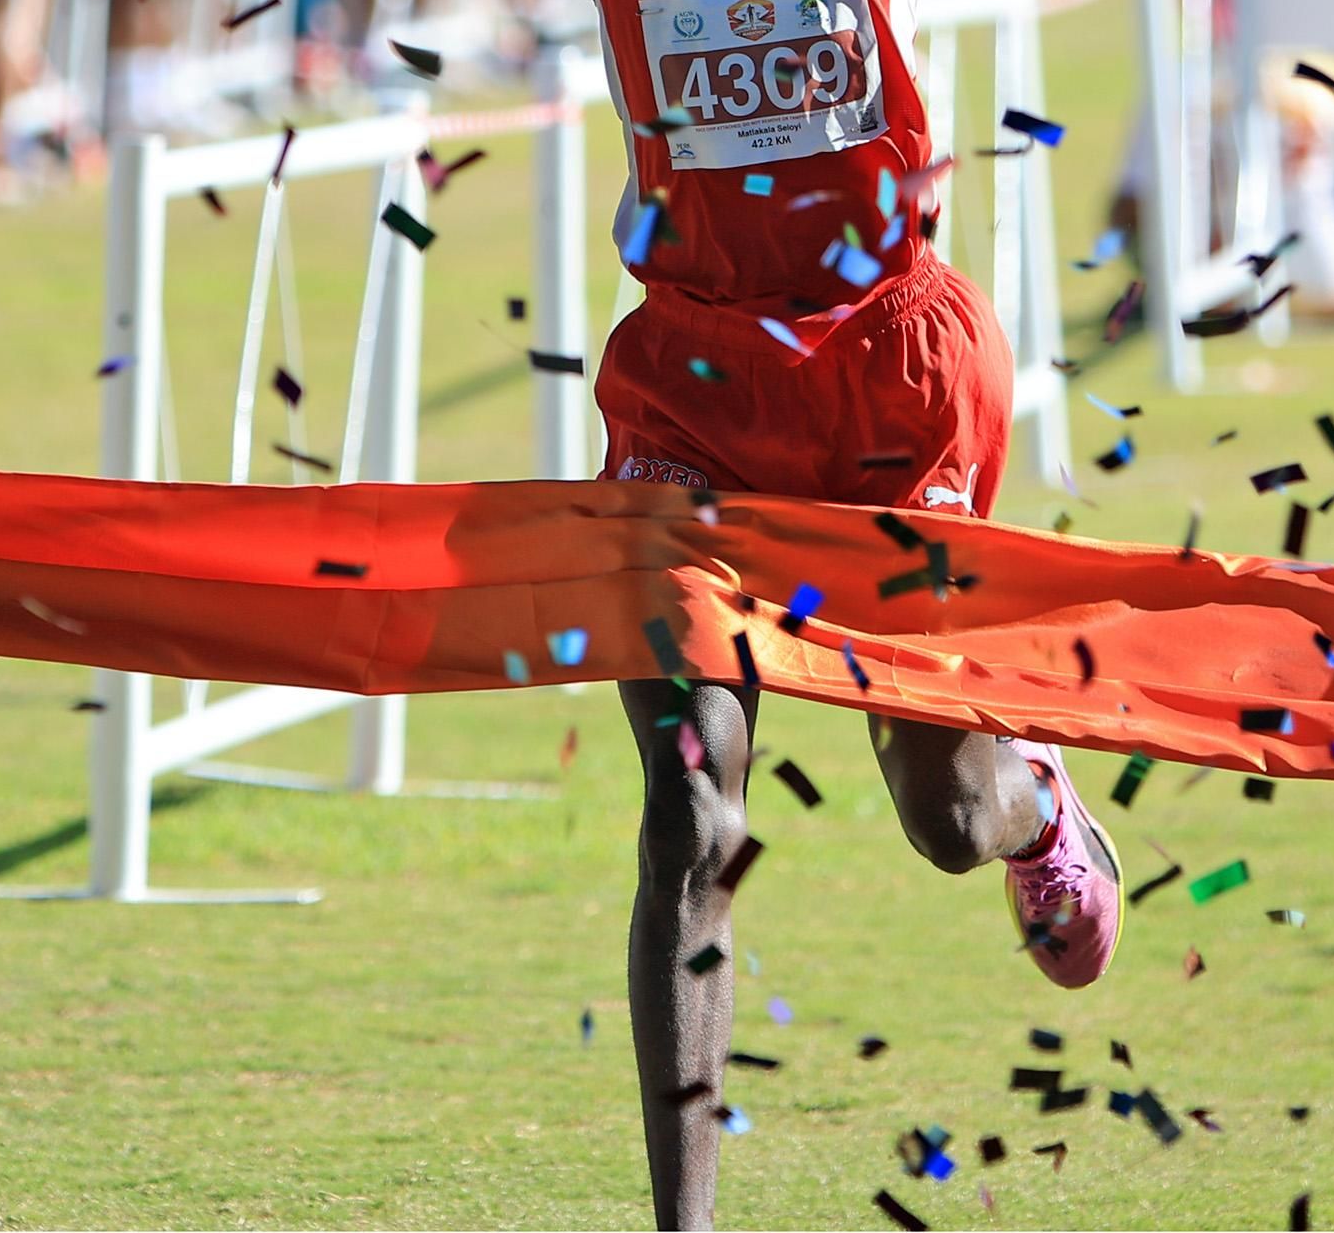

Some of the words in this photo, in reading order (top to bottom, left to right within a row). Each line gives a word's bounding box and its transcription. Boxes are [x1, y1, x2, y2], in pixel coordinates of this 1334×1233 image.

[681, 40, 849, 120] 4309
[738, 125, 775, 138] Matlakala
[777, 122, 801, 133] Seloyi
[752, 138, 773, 149] 42.2
[776, 136, 791, 146] KM
